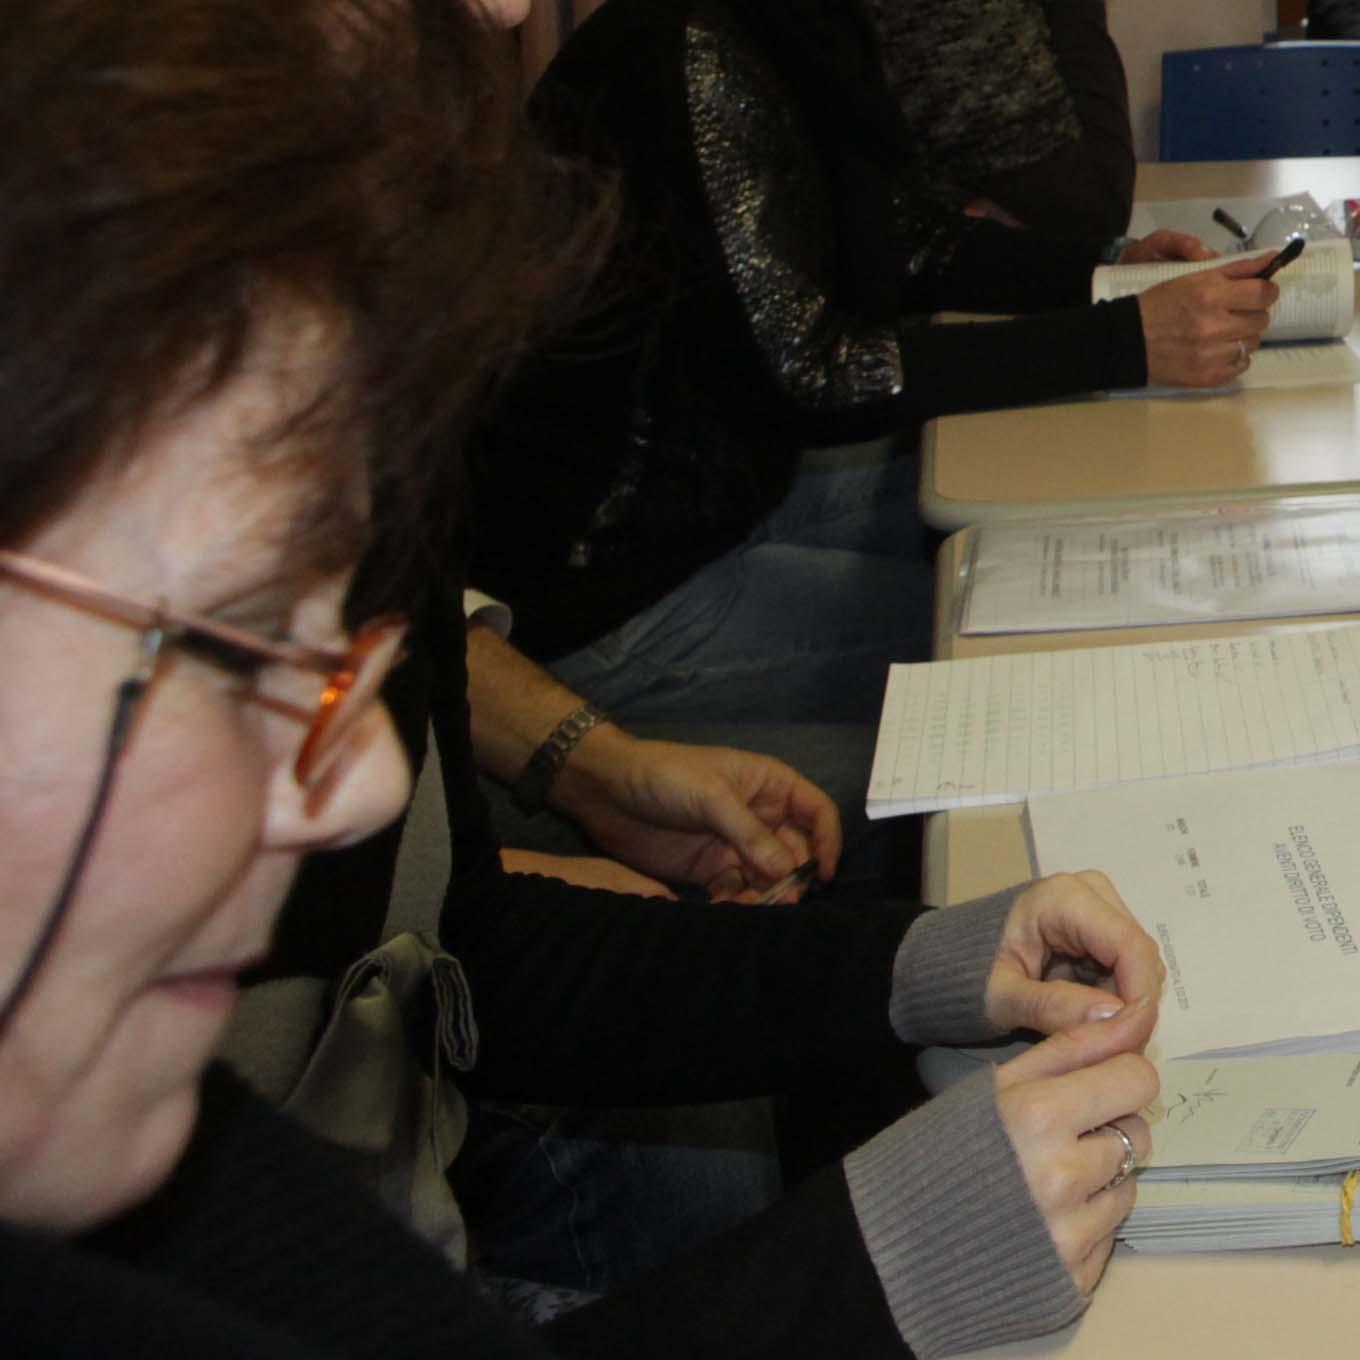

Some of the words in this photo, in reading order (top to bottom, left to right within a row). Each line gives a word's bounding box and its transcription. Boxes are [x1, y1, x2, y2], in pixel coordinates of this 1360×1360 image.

[1288, 825, 1315, 859] ELENCO
[1303, 858, 1336, 902] GENERALE
[1284, 871, 1311, 905] DIRITTO
[1302, 917, 1327, 941] VOTO
